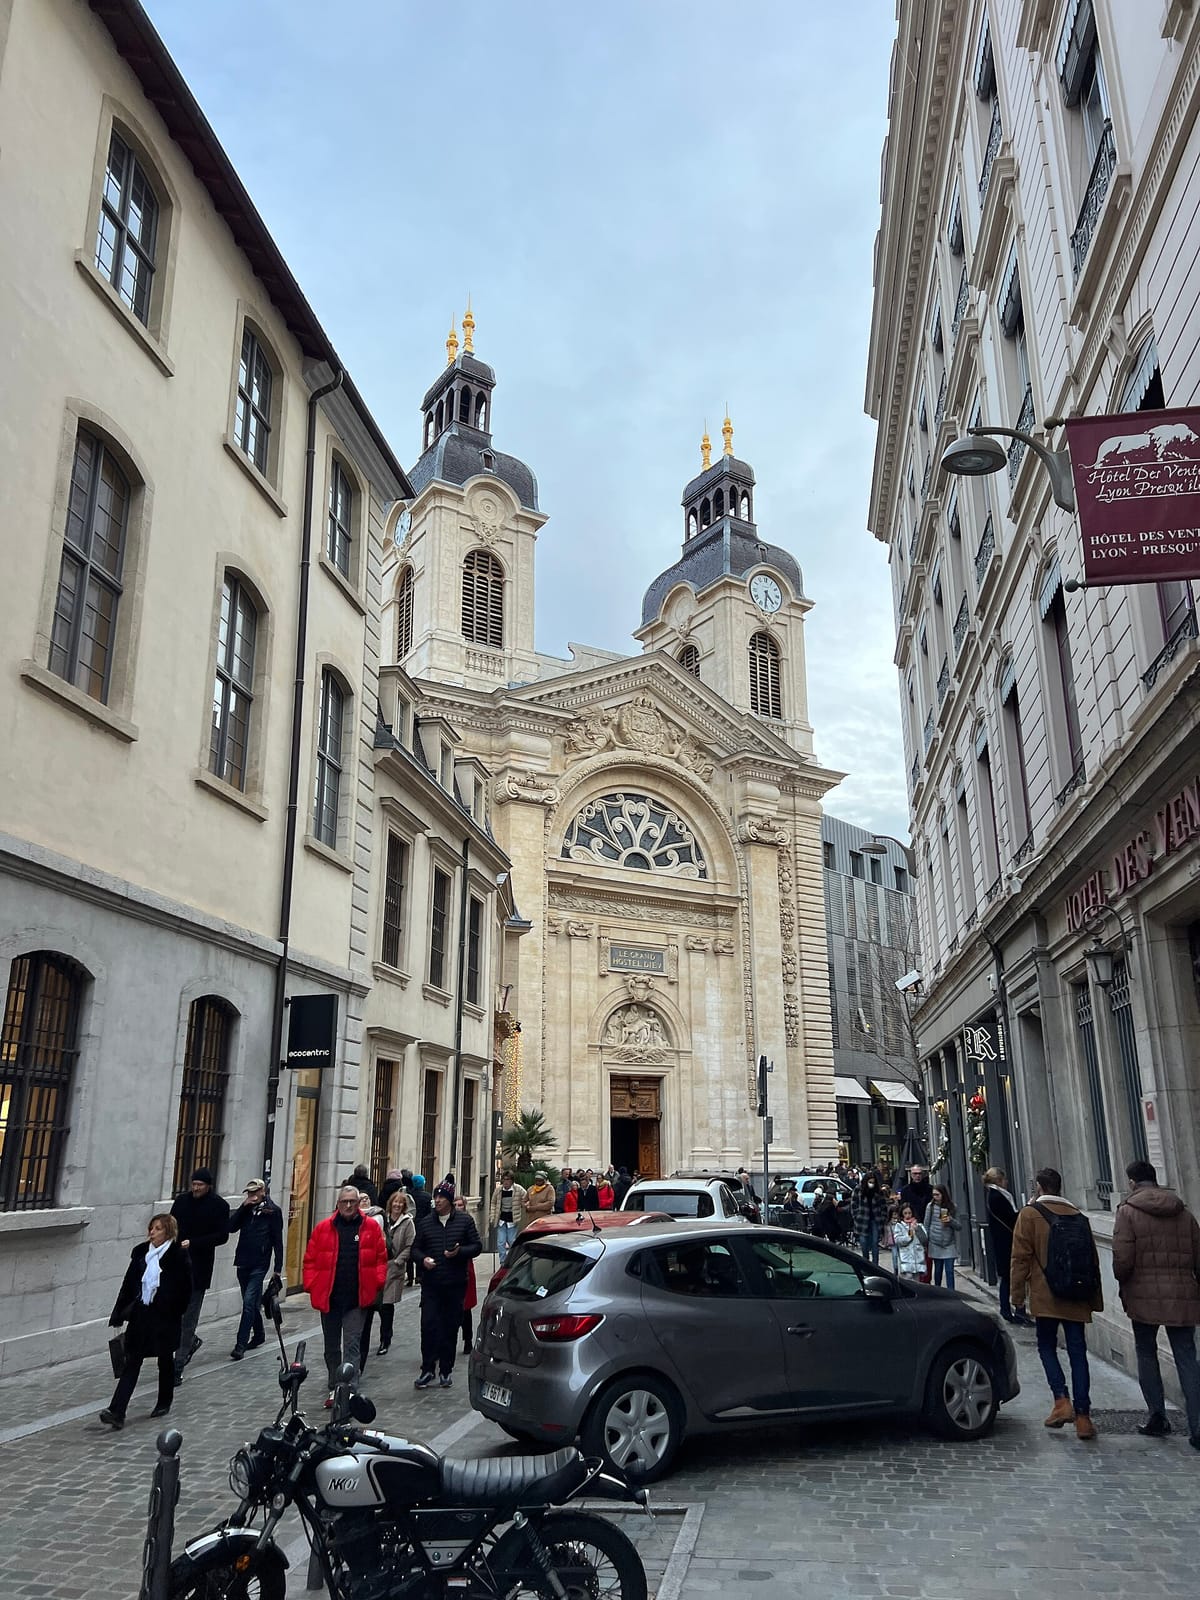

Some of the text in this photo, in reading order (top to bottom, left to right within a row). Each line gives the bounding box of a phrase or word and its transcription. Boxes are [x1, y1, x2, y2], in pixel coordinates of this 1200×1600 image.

[1087, 466, 1131, 484] Hôtel
[1133, 467, 1161, 480] Des
[1095, 485, 1131, 503] Lyon
[1090, 533, 1136, 545] HÔTEL
[1139, 530, 1165, 542] DES
[1092, 547, 1128, 559] LYON
[1142, 542, 1200, 555] PRESQU'
[1112, 831, 1153, 896] DES
[288, 1048, 330, 1057] ecocentric
